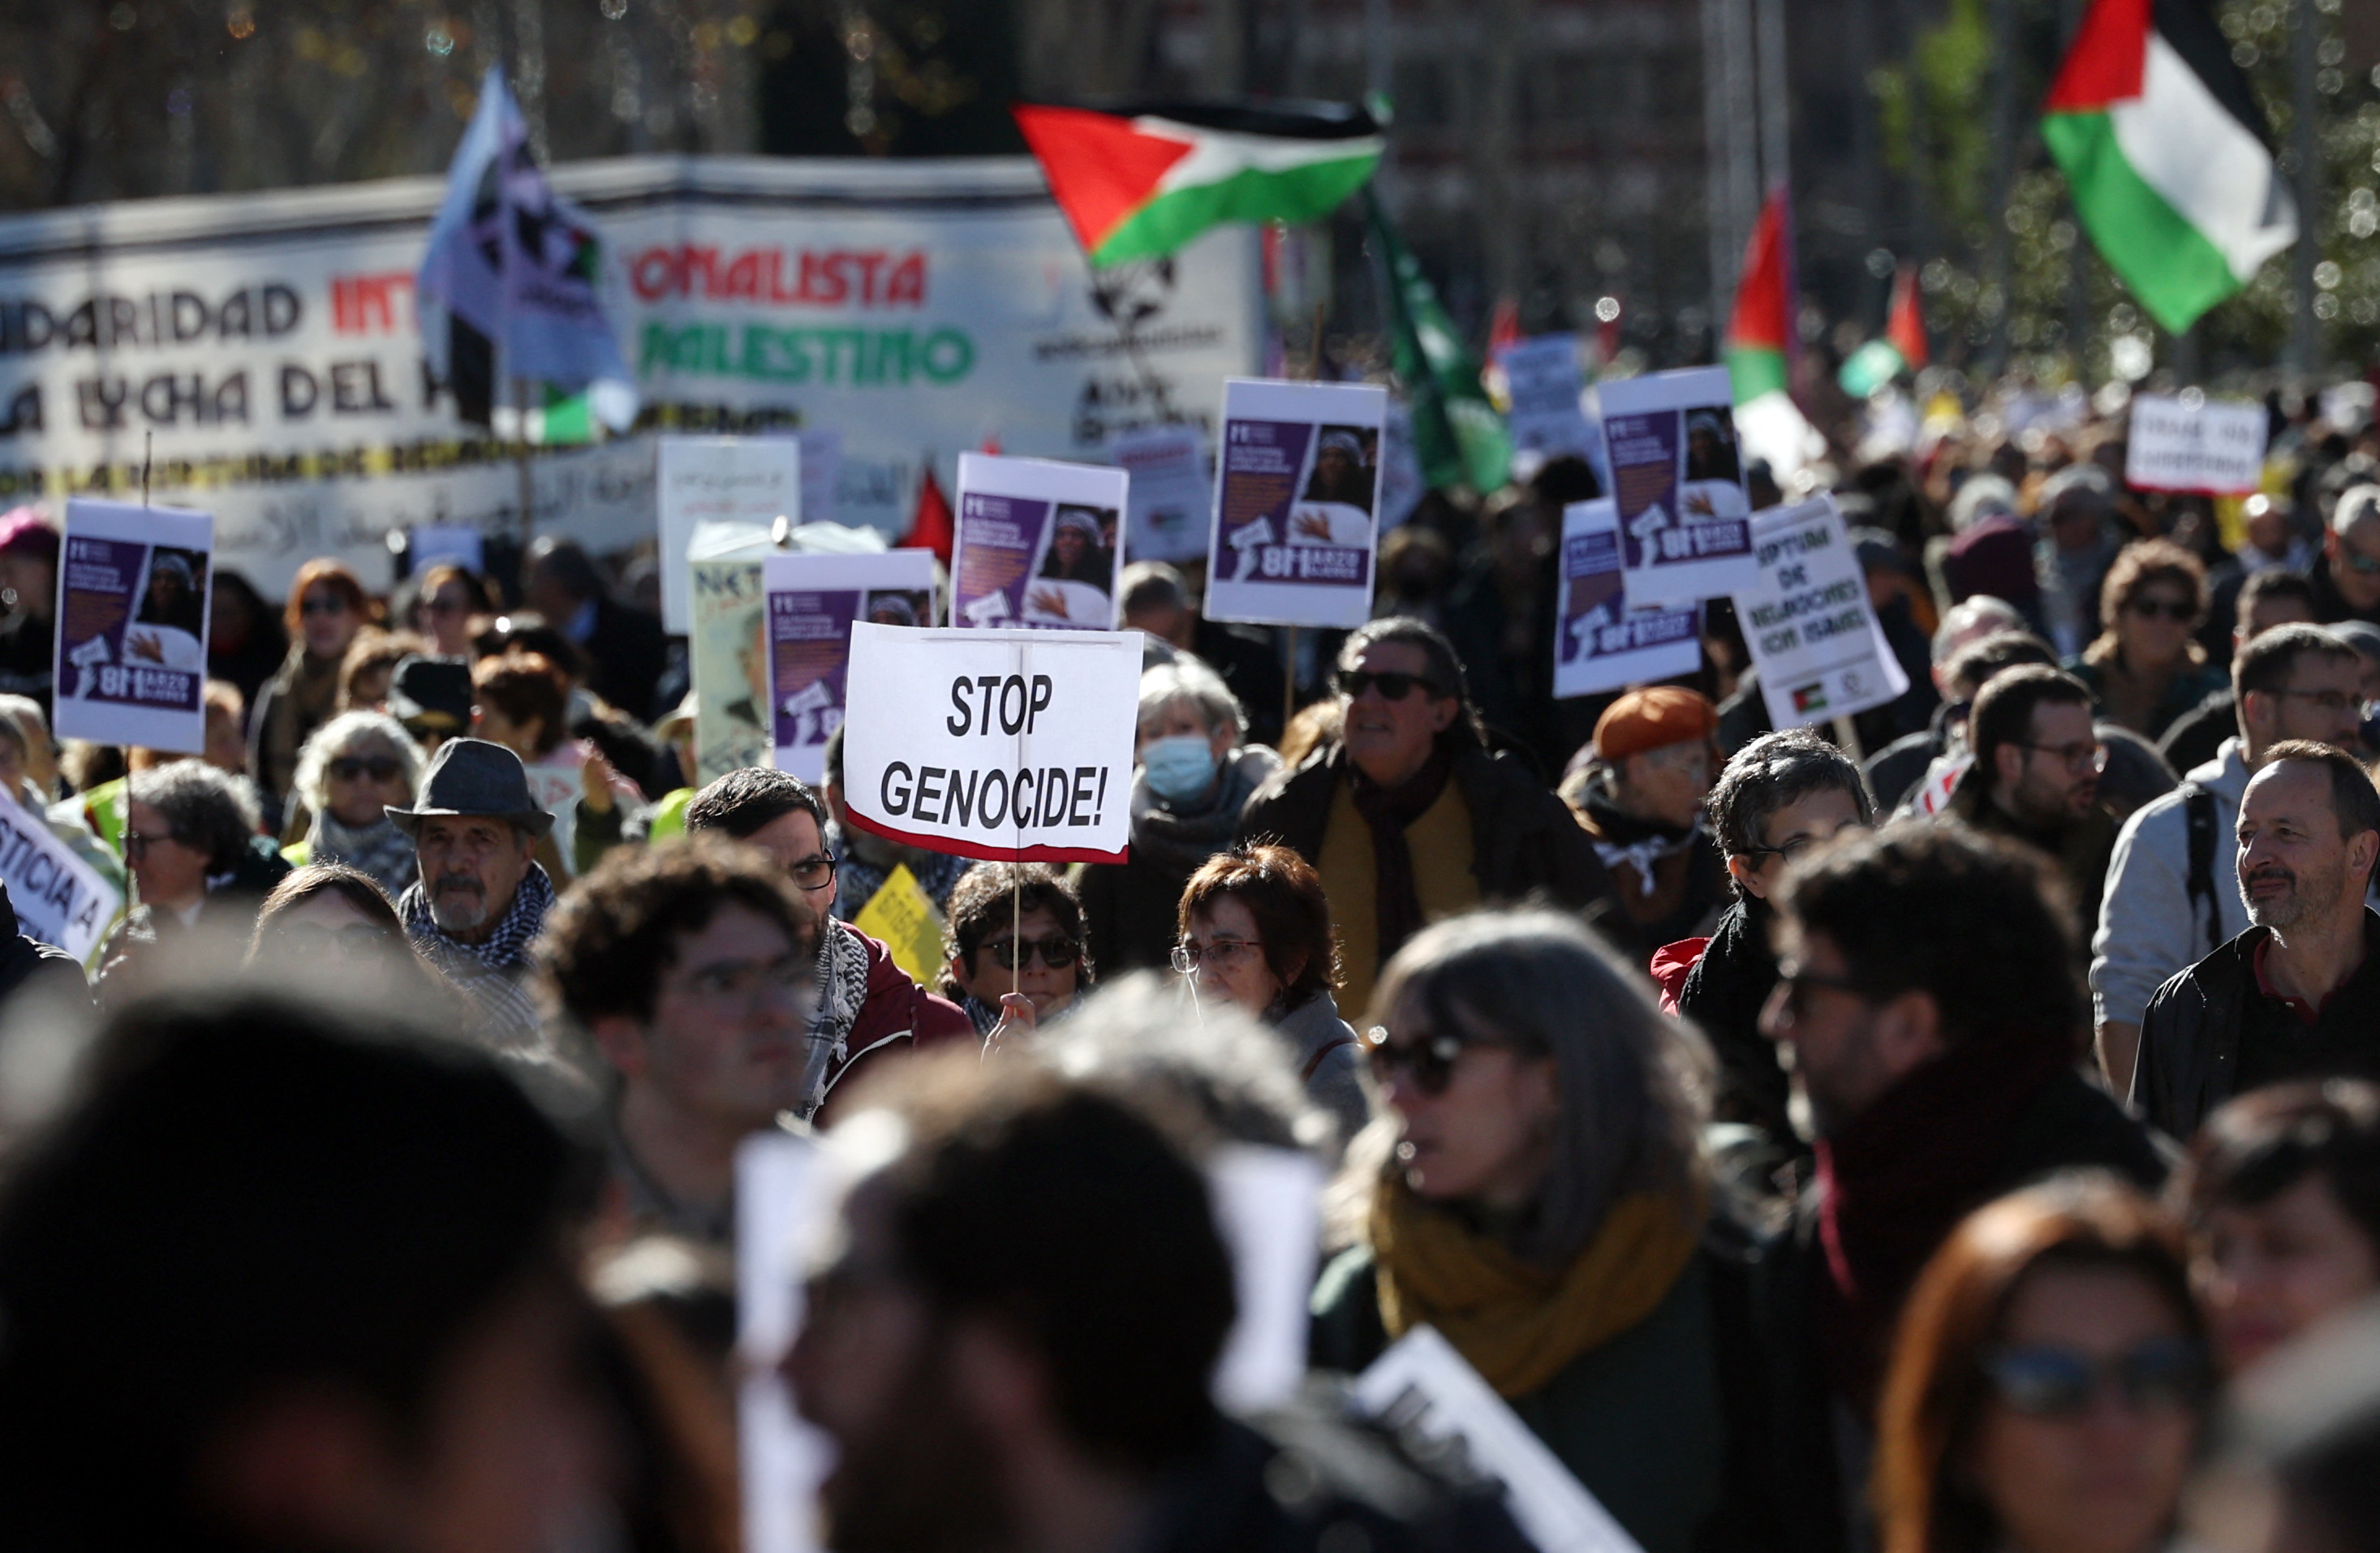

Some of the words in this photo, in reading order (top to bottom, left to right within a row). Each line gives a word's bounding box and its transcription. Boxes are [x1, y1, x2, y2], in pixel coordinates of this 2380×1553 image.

[281, 357, 395, 418] DEL
[641, 319, 975, 388] PALESTINO
[946, 673, 1052, 738] STOP
[880, 760, 1108, 829] GENOCIDE!
